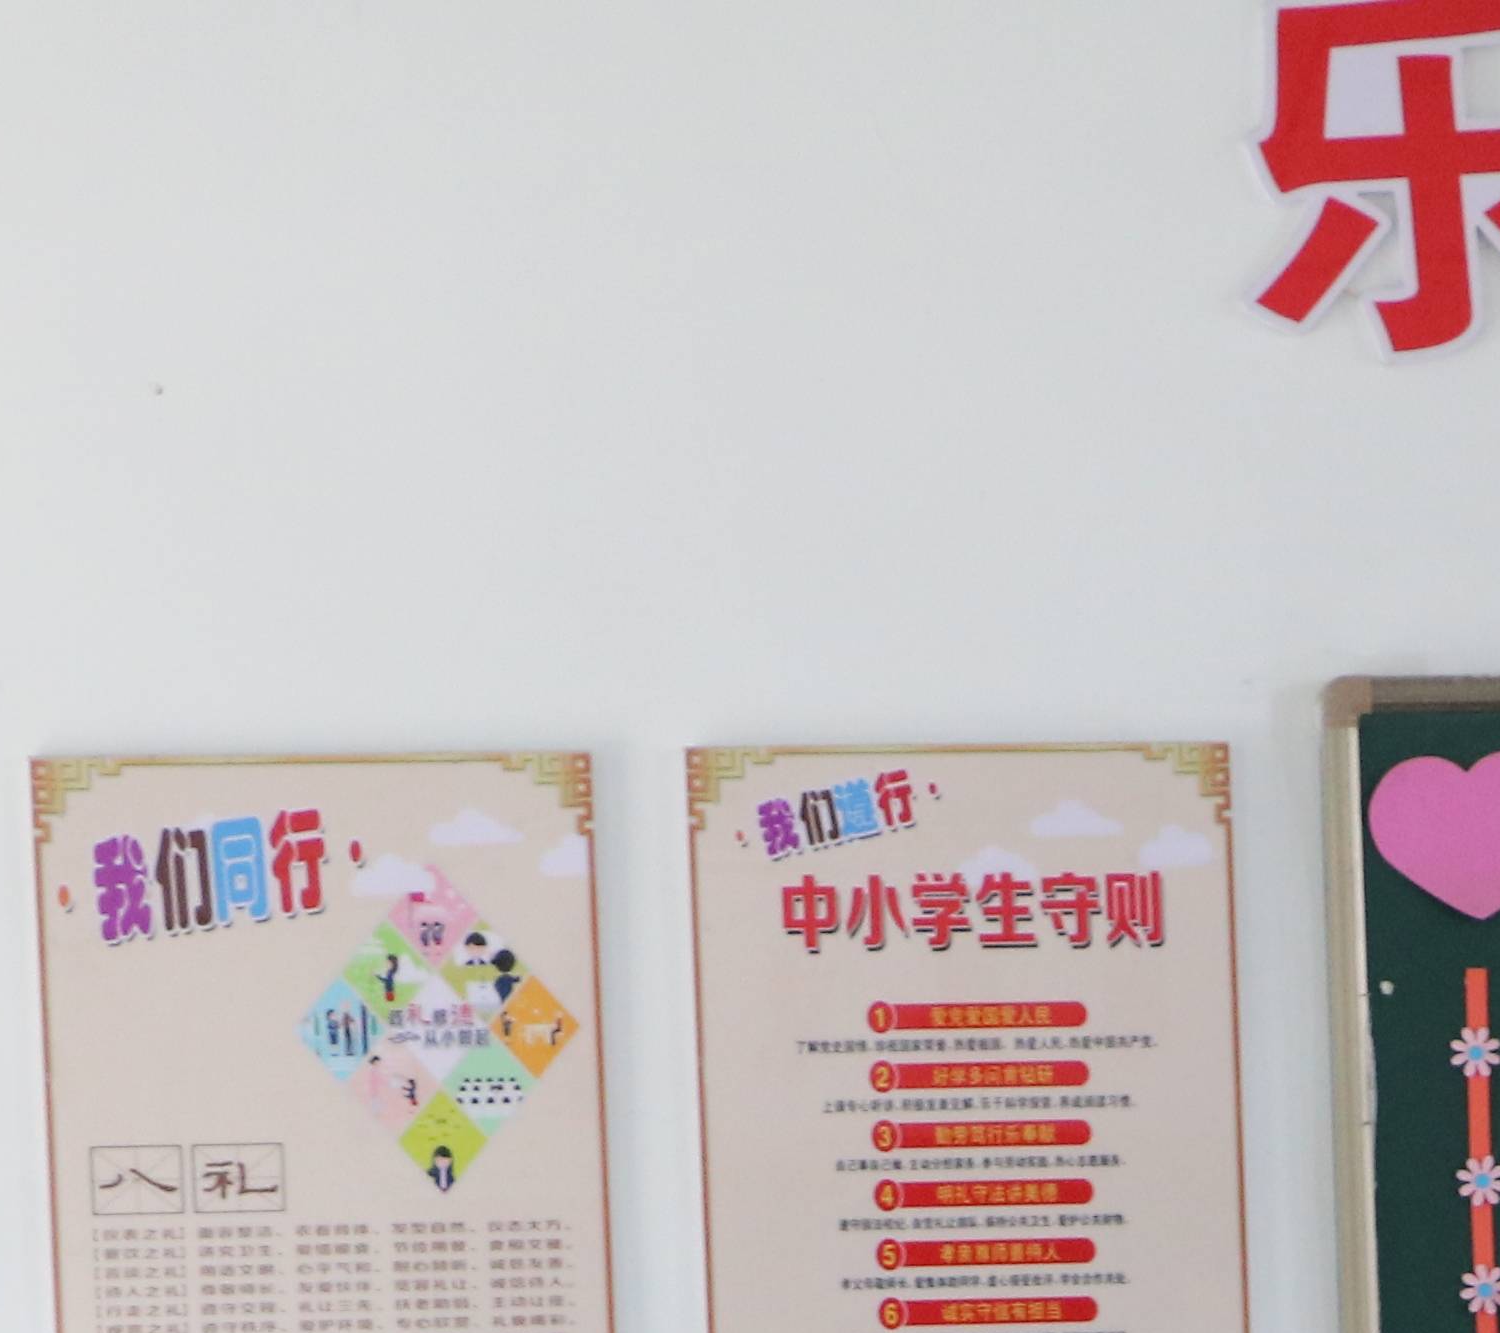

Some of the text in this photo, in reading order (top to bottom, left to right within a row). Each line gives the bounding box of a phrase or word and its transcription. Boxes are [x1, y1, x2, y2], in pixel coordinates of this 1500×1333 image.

[94, 809, 324, 942] 我们同行
[782, 871, 1165, 952] 中小学生守则
[99, 1161, 279, 1201] 八礼
